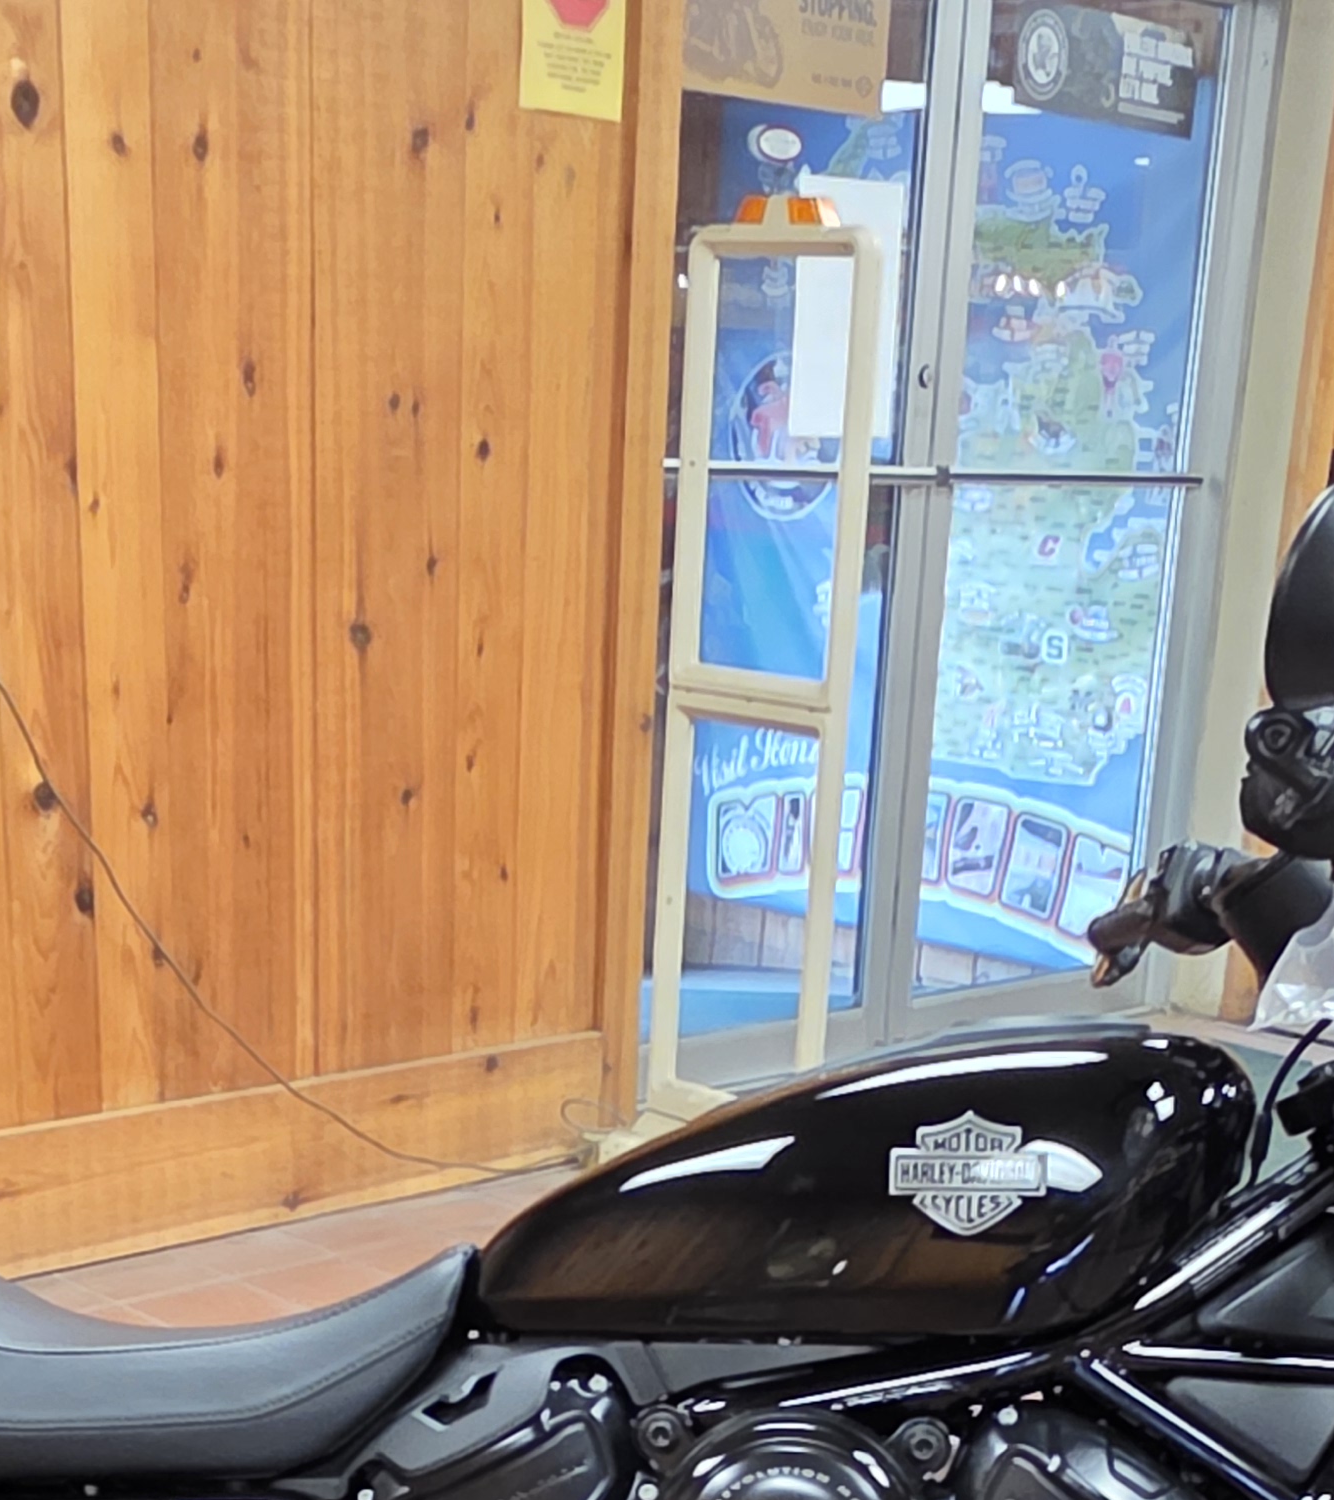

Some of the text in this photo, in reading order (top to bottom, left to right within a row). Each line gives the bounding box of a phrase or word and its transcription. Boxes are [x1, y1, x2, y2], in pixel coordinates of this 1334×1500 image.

[933, 1127, 1003, 1152] MOTOR
[900, 1161, 1035, 1185] HARLEY-DAVIDSON
[930, 1194, 1002, 1223] CYCLES
